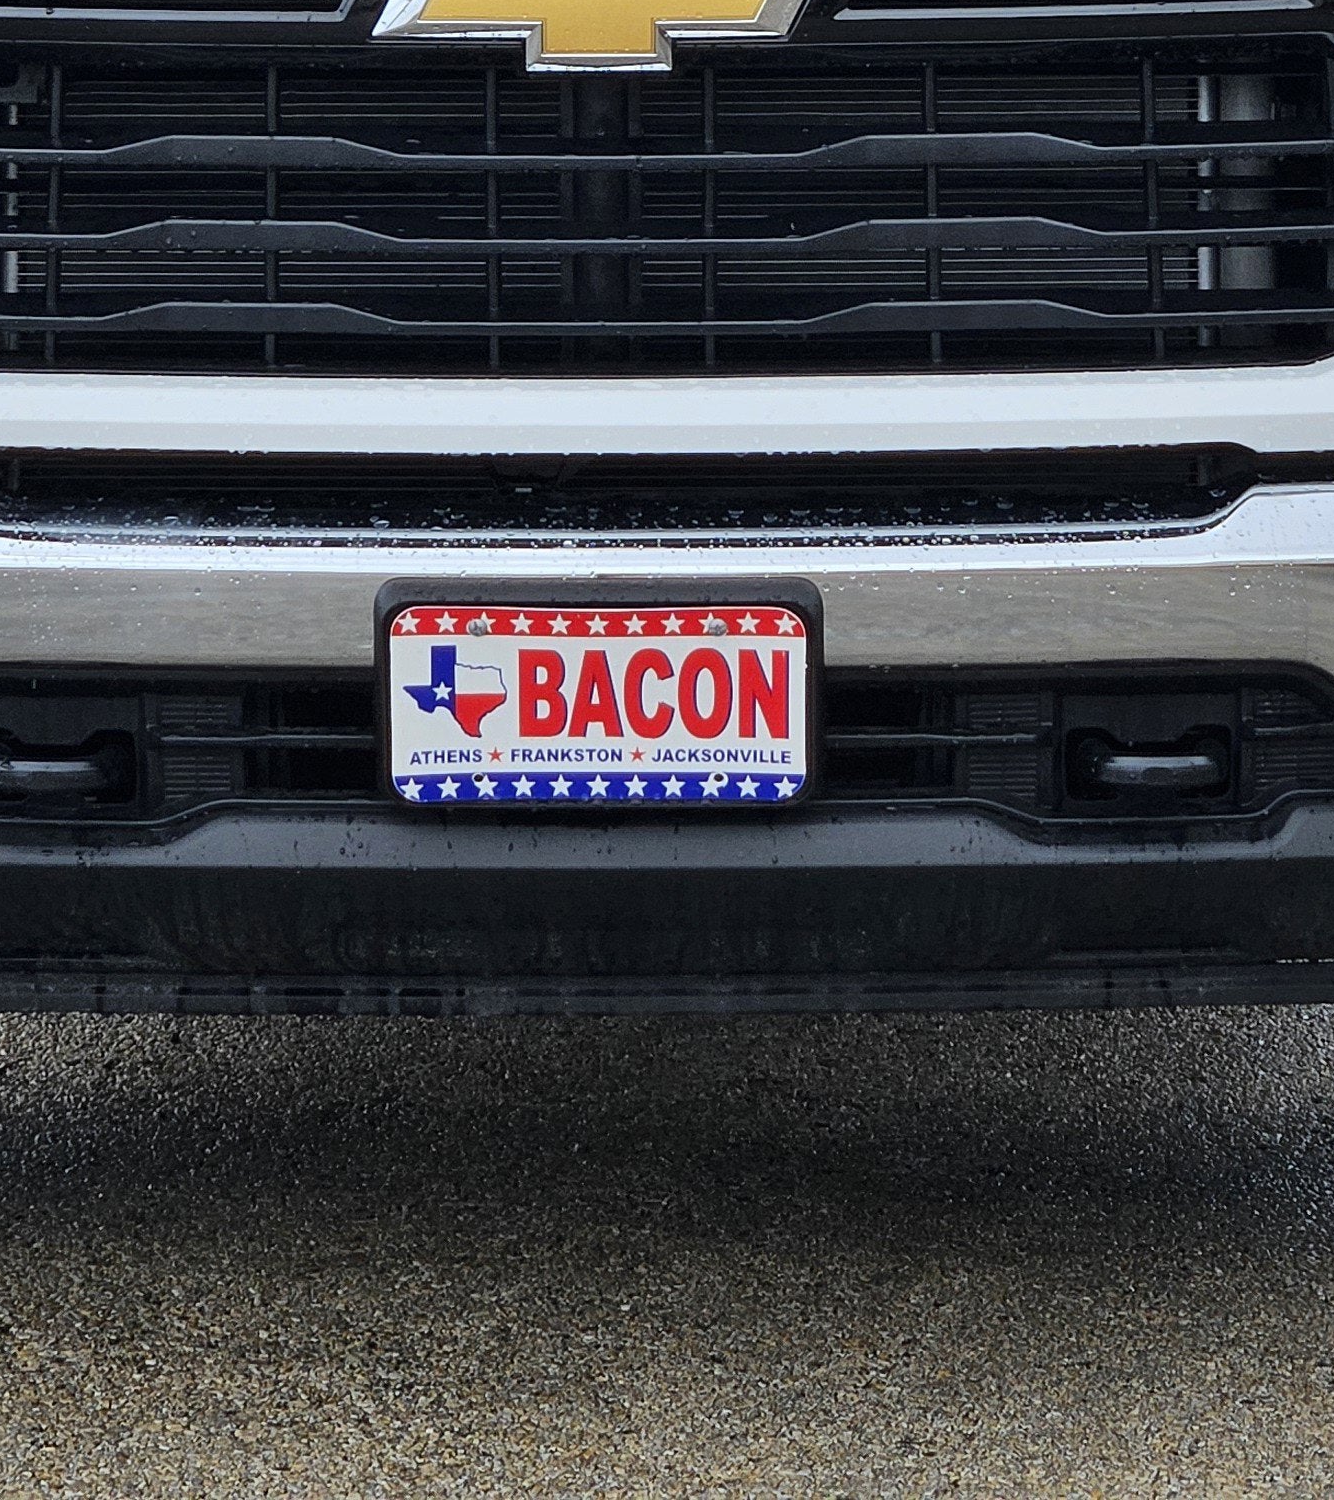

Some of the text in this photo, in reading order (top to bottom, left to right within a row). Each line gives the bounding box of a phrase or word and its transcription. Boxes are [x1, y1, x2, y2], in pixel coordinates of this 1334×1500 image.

[517, 647, 791, 739] BACON
[409, 748, 793, 765] ATHENS FRANKSTON JACKSONVILLE
